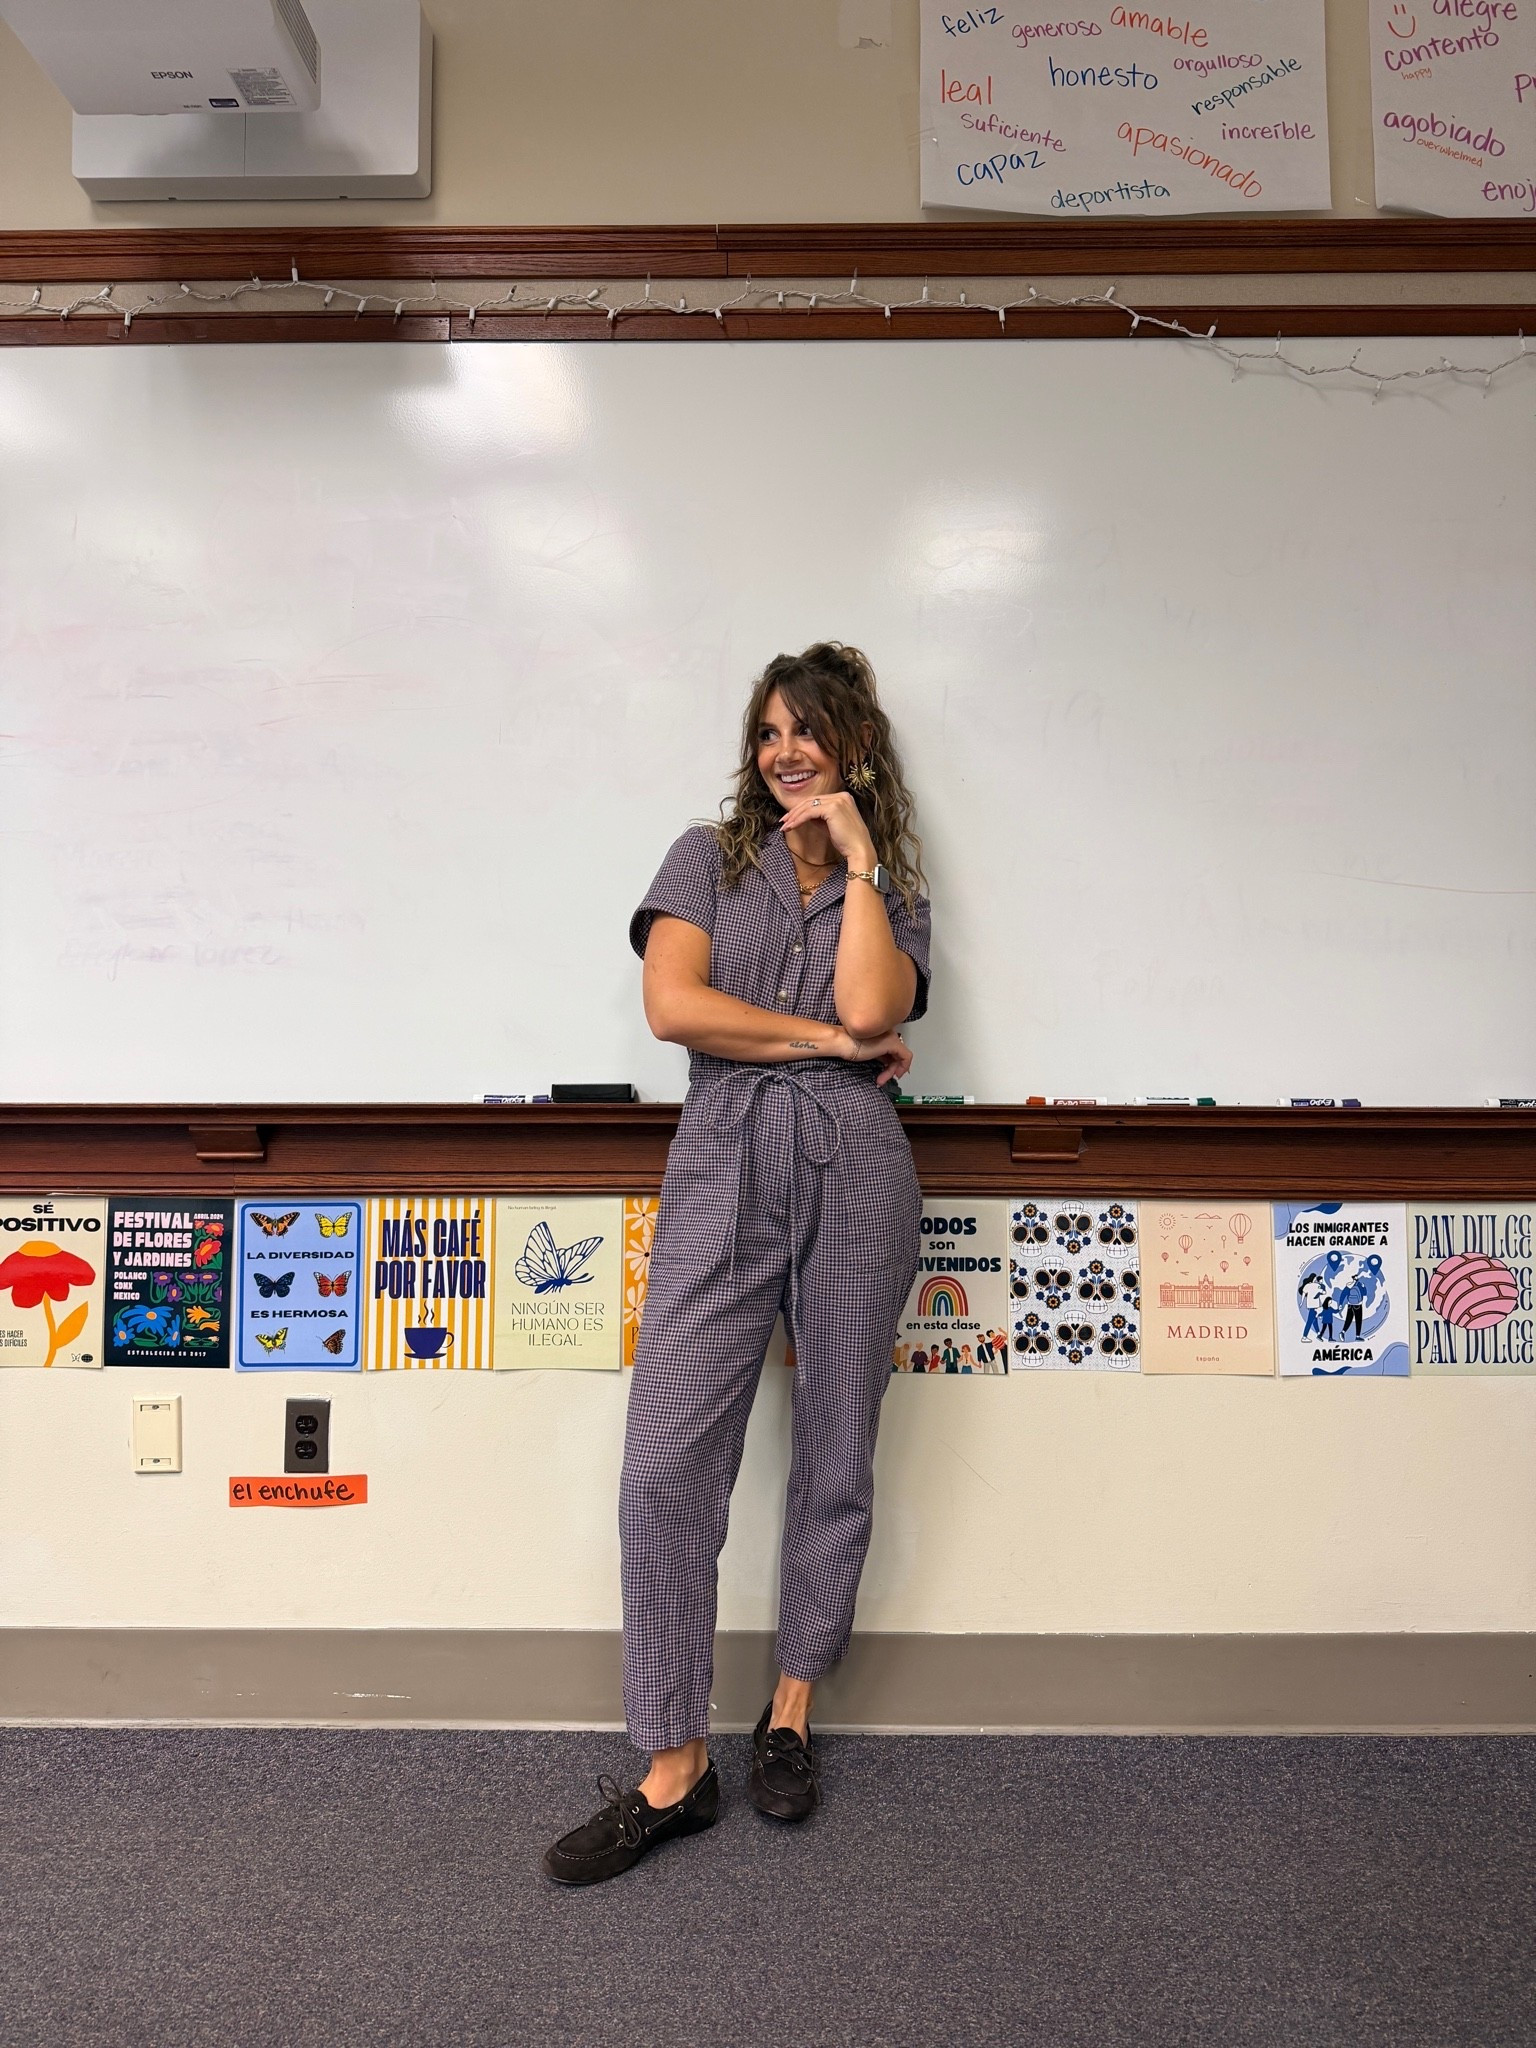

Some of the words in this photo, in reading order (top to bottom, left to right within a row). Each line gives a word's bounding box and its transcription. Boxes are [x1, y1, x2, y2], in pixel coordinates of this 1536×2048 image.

[941, 7, 1005, 37] feliz
[1433, 0, 1518, 33] alegre
[1011, 20, 1103, 48] generoso
[1110, 5, 1209, 48] amable
[1384, 28, 1500, 72] contento
[150, 70, 194, 79] EPSON
[1048, 56, 1159, 90] honesto
[1173, 52, 1263, 78] orgulloso
[1401, 66, 1433, 81] happy
[940, 69, 993, 106] leal
[1191, 56, 1303, 116] responsable
[961, 112, 1067, 153] suficiente
[1383, 112, 1506, 157] agobiado
[1117, 121, 1262, 198] apasionado
[1416, 137, 1484, 169] overwhelmed
[956, 149, 1046, 186] capaz
[1050, 179, 1171, 213] deportista
[1480, 178, 1536, 212] enoj
[33, 1201, 54, 1214] SÉ
[113, 1211, 193, 1229] FESTIVAL
[920, 1217, 977, 1235] ODOS
[1289, 1222, 1310, 1233] LOS
[1313, 1222, 1389, 1233] INMIGRANTES
[113, 1232, 133, 1248] DE
[135, 1232, 192, 1249] FLORES
[382, 1209, 427, 1258] MÁS
[432, 1209, 482, 1258] CAFÉ
[1286, 1236, 1325, 1247] HACEN
[1329, 1235, 1375, 1246] GRANDE
[1379, 1235, 1388, 1246] A
[1414, 1214, 1455, 1259] PAN
[1462, 1214, 1532, 1259] DULCE
[929, 1241, 955, 1250] son
[113, 1252, 123, 1267] Y
[124, 1252, 192, 1268] JARDINES
[247, 1252, 266, 1260] LA
[268, 1251, 354, 1260] DIVERSIDAD
[918, 1257, 1002, 1272] VENIDOS
[114, 1271, 147, 1280] POLANCO
[375, 1260, 416, 1300] POR
[422, 1260, 487, 1300] FAVOR
[250, 1310, 270, 1319] ES
[272, 1309, 348, 1318] HERMOSA
[511, 1300, 570, 1315] NINGÚN
[574, 1302, 605, 1315] SER
[7, 1329, 24, 1338] HACER
[512, 1318, 579, 1331] HUMANO
[583, 1318, 604, 1331] ES
[906, 1322, 921, 1330] en
[923, 1320, 949, 1330] esta
[951, 1319, 981, 1330] clase
[1167, 1325, 1248, 1340] MADRID
[528, 1333, 583, 1347] ILEGAL
[1416, 1320, 1457, 1364] PAN
[1465, 1319, 1534, 1364] DULCE
[1312, 1345, 1373, 1361] AMÉRICA
[232, 1483, 253, 1500] el
[258, 1480, 355, 1501] enchufe
